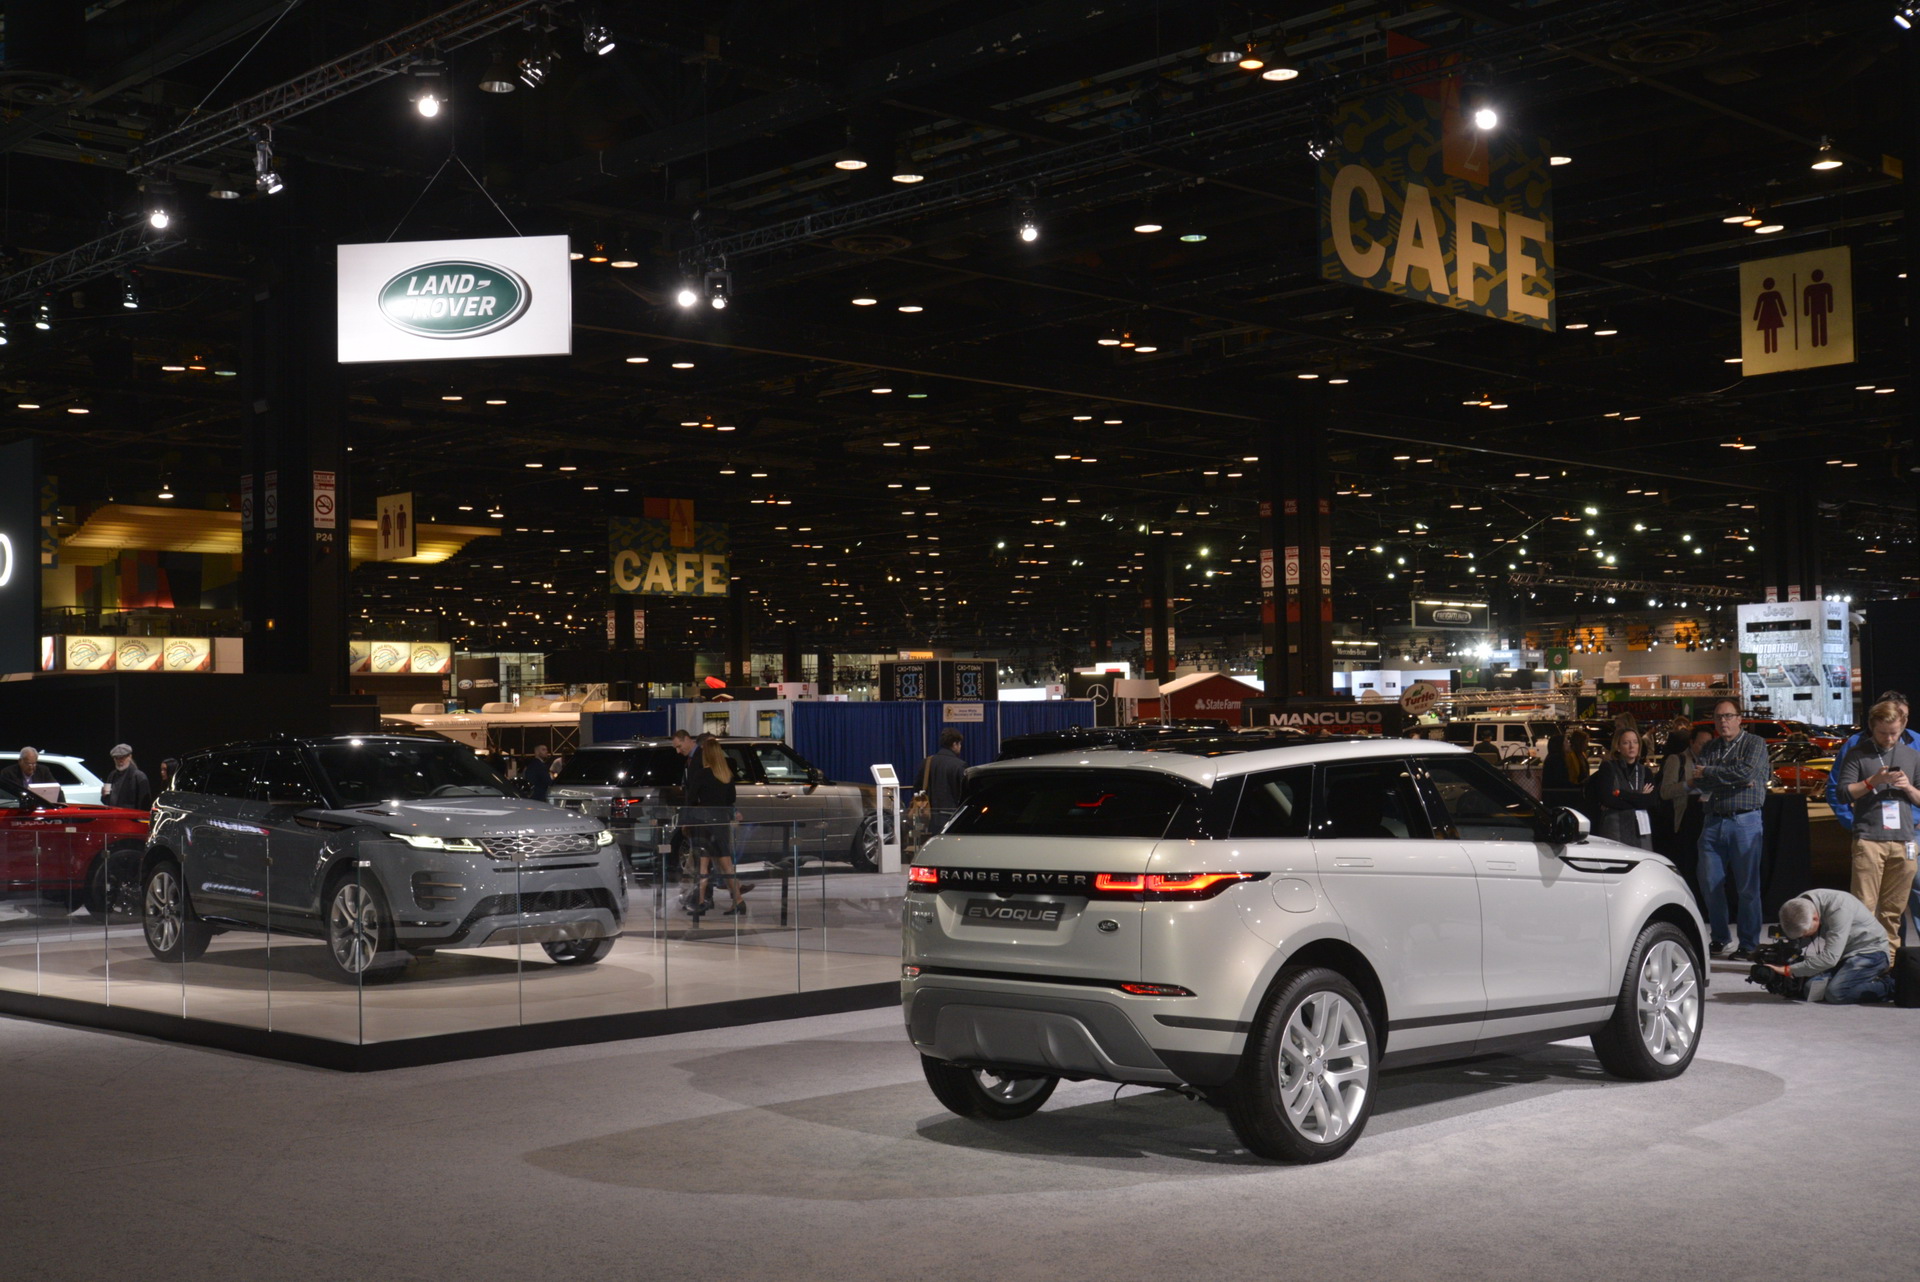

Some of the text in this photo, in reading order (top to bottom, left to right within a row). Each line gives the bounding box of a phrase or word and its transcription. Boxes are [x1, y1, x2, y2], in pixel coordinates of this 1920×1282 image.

[1330, 163, 1550, 321] CAFE
[316, 533, 333, 541] P24
[614, 549, 727, 593] CAFE
[1763, 605, 1794, 618] Jeep
[1405, 692, 1435, 707] Turtle
[1269, 711, 1383, 726] MANCUSO
[940, 869, 1087, 885] RANGE ROVER
[968, 905, 1058, 922] EVOQUE
